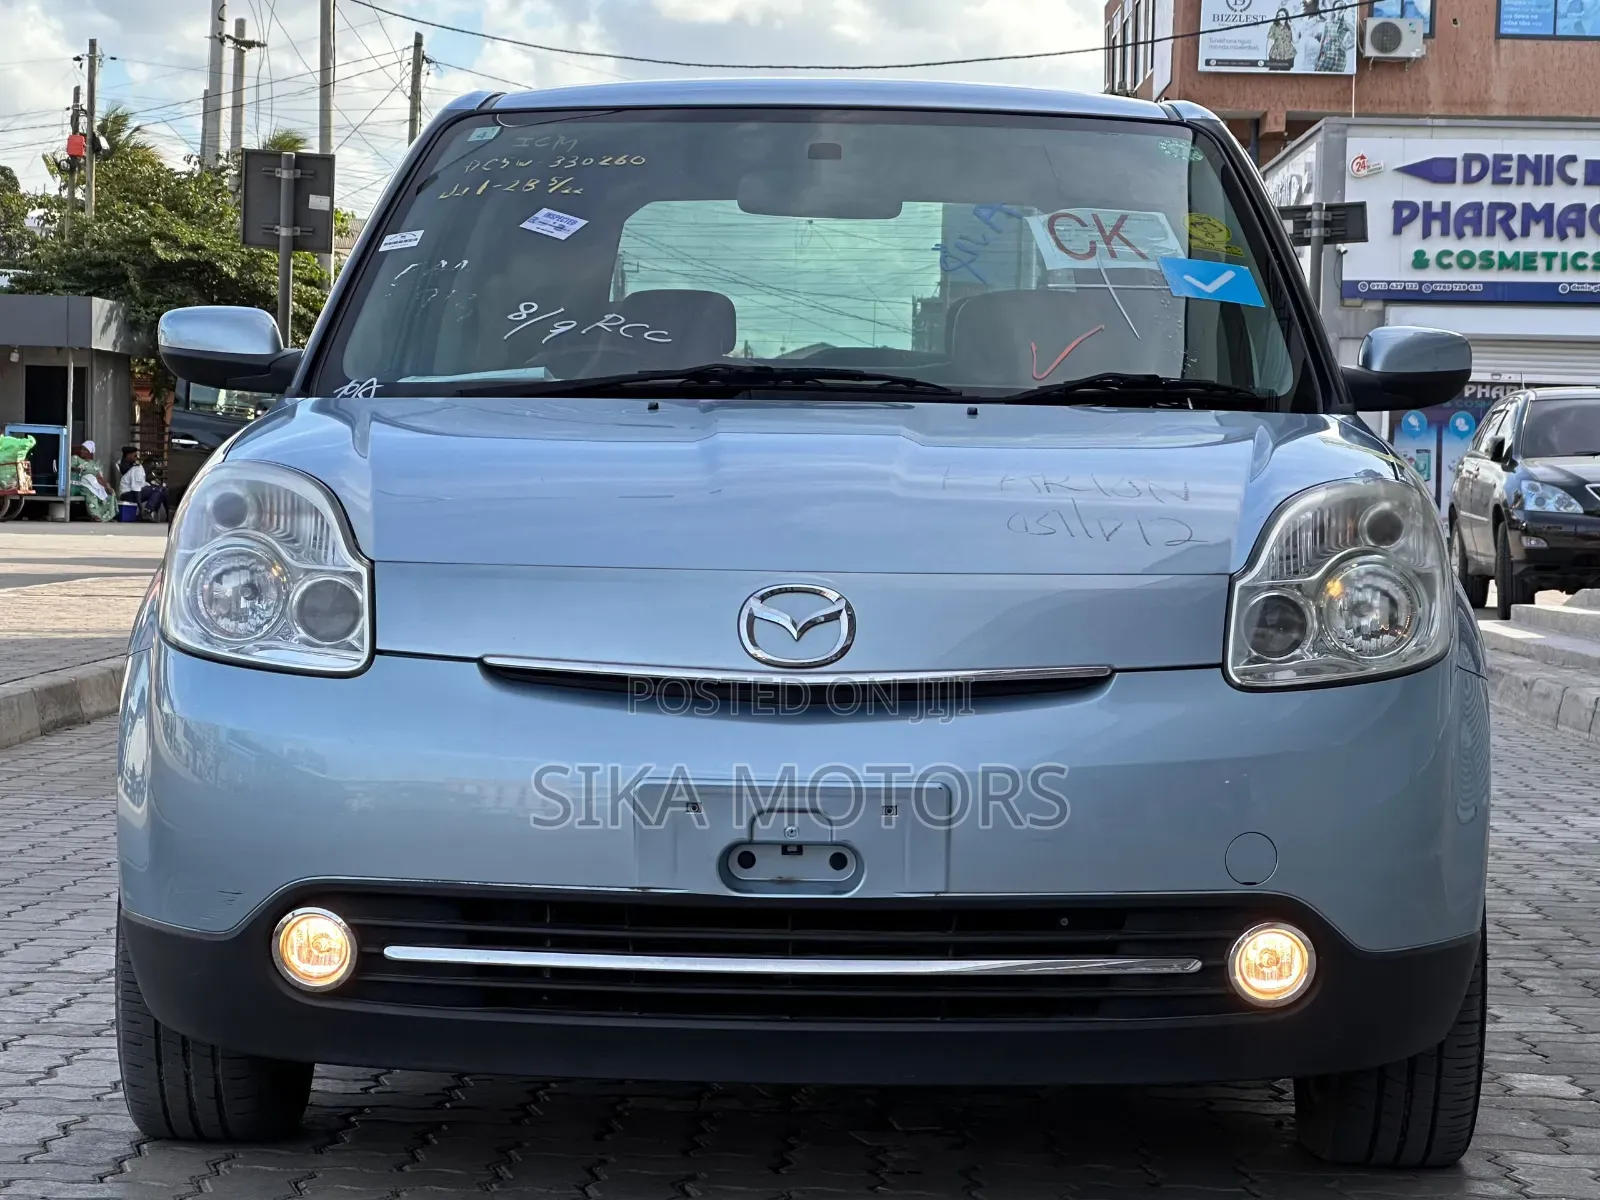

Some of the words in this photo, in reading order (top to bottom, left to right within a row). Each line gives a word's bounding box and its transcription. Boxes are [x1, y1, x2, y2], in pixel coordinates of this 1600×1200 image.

[1212, 13, 1267, 23] BIZZLEST
[1356, 160, 1366, 172] 24
[1462, 152, 1578, 186] DENIC
[543, 211, 579, 226] INSPECTED
[1048, 212, 1150, 260] CK
[1411, 249, 1430, 269] &
